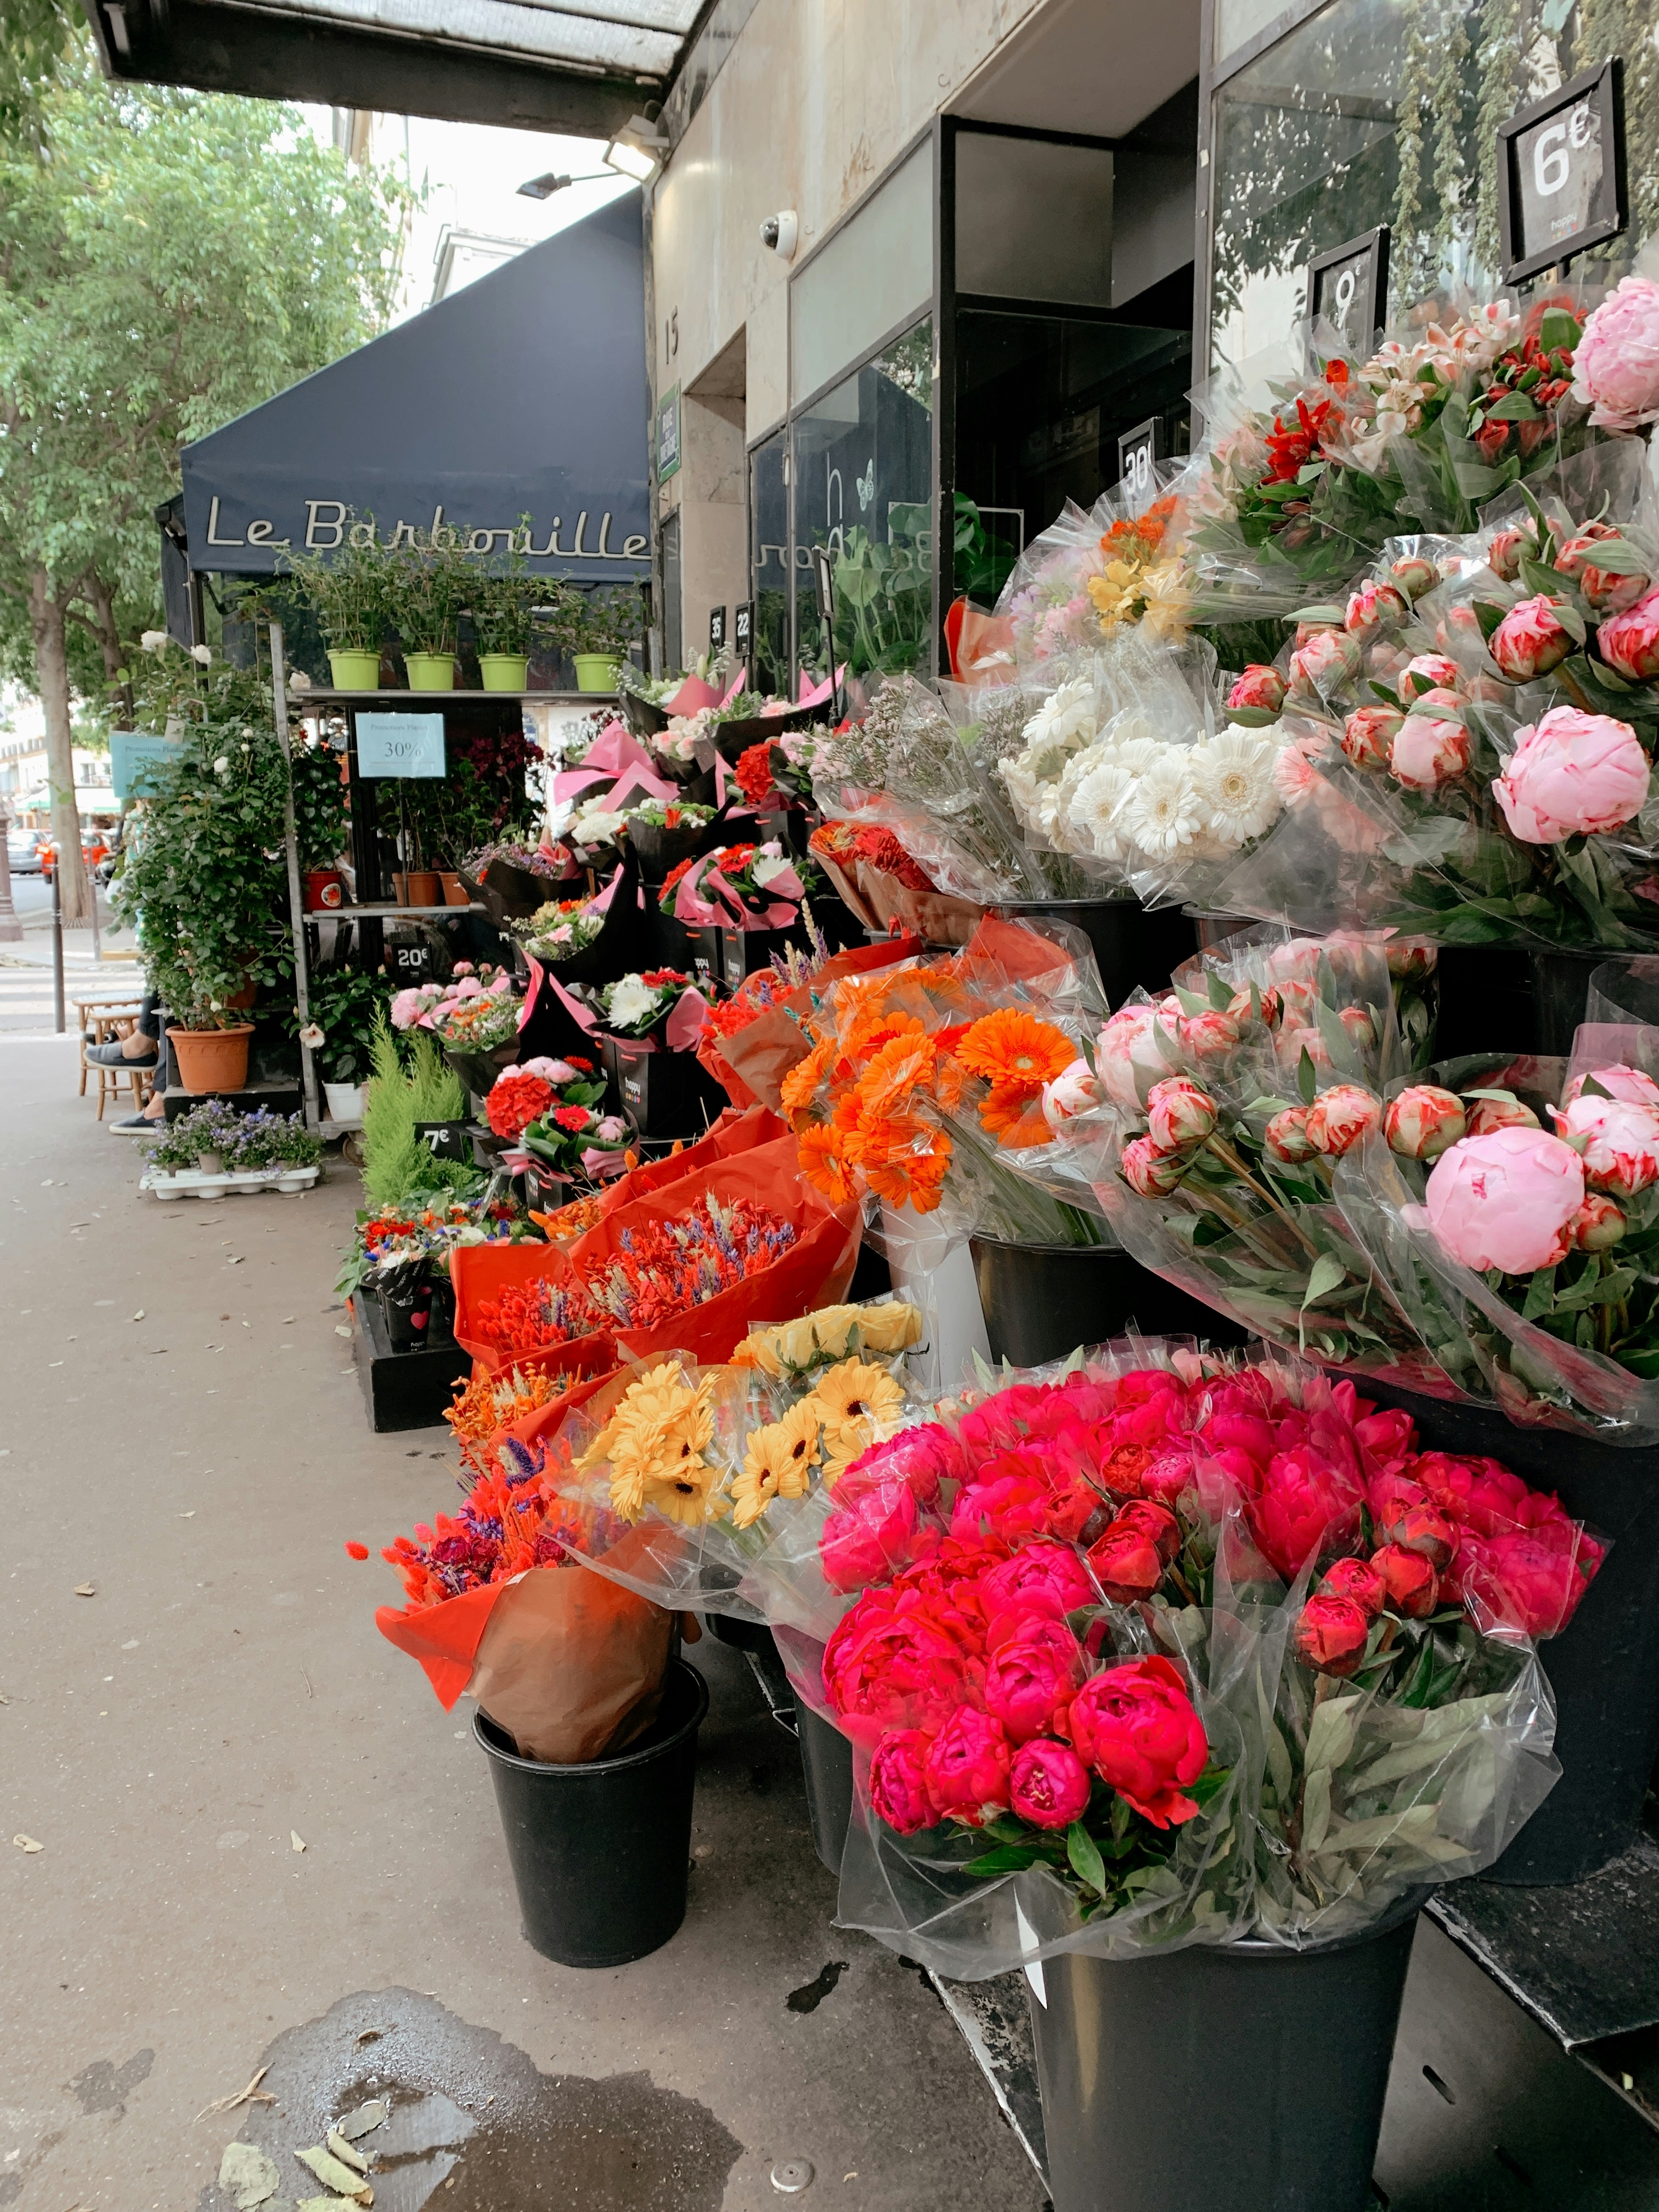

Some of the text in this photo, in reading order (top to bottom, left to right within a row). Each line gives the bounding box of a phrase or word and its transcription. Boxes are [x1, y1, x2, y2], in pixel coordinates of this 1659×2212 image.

[1533, 103, 1591, 196] 6€
[1550, 212, 1578, 231] happy
[665, 305, 679, 365] 15
[207, 495, 653, 561] Le Barbouille
[737, 612, 749, 636] 22
[385, 742, 421, 758] 30%
[398, 948, 428, 966] 20€
[728, 958, 740, 976] happy
[625, 1076, 641, 1096] happy
[424, 1129, 449, 1151] 7€
